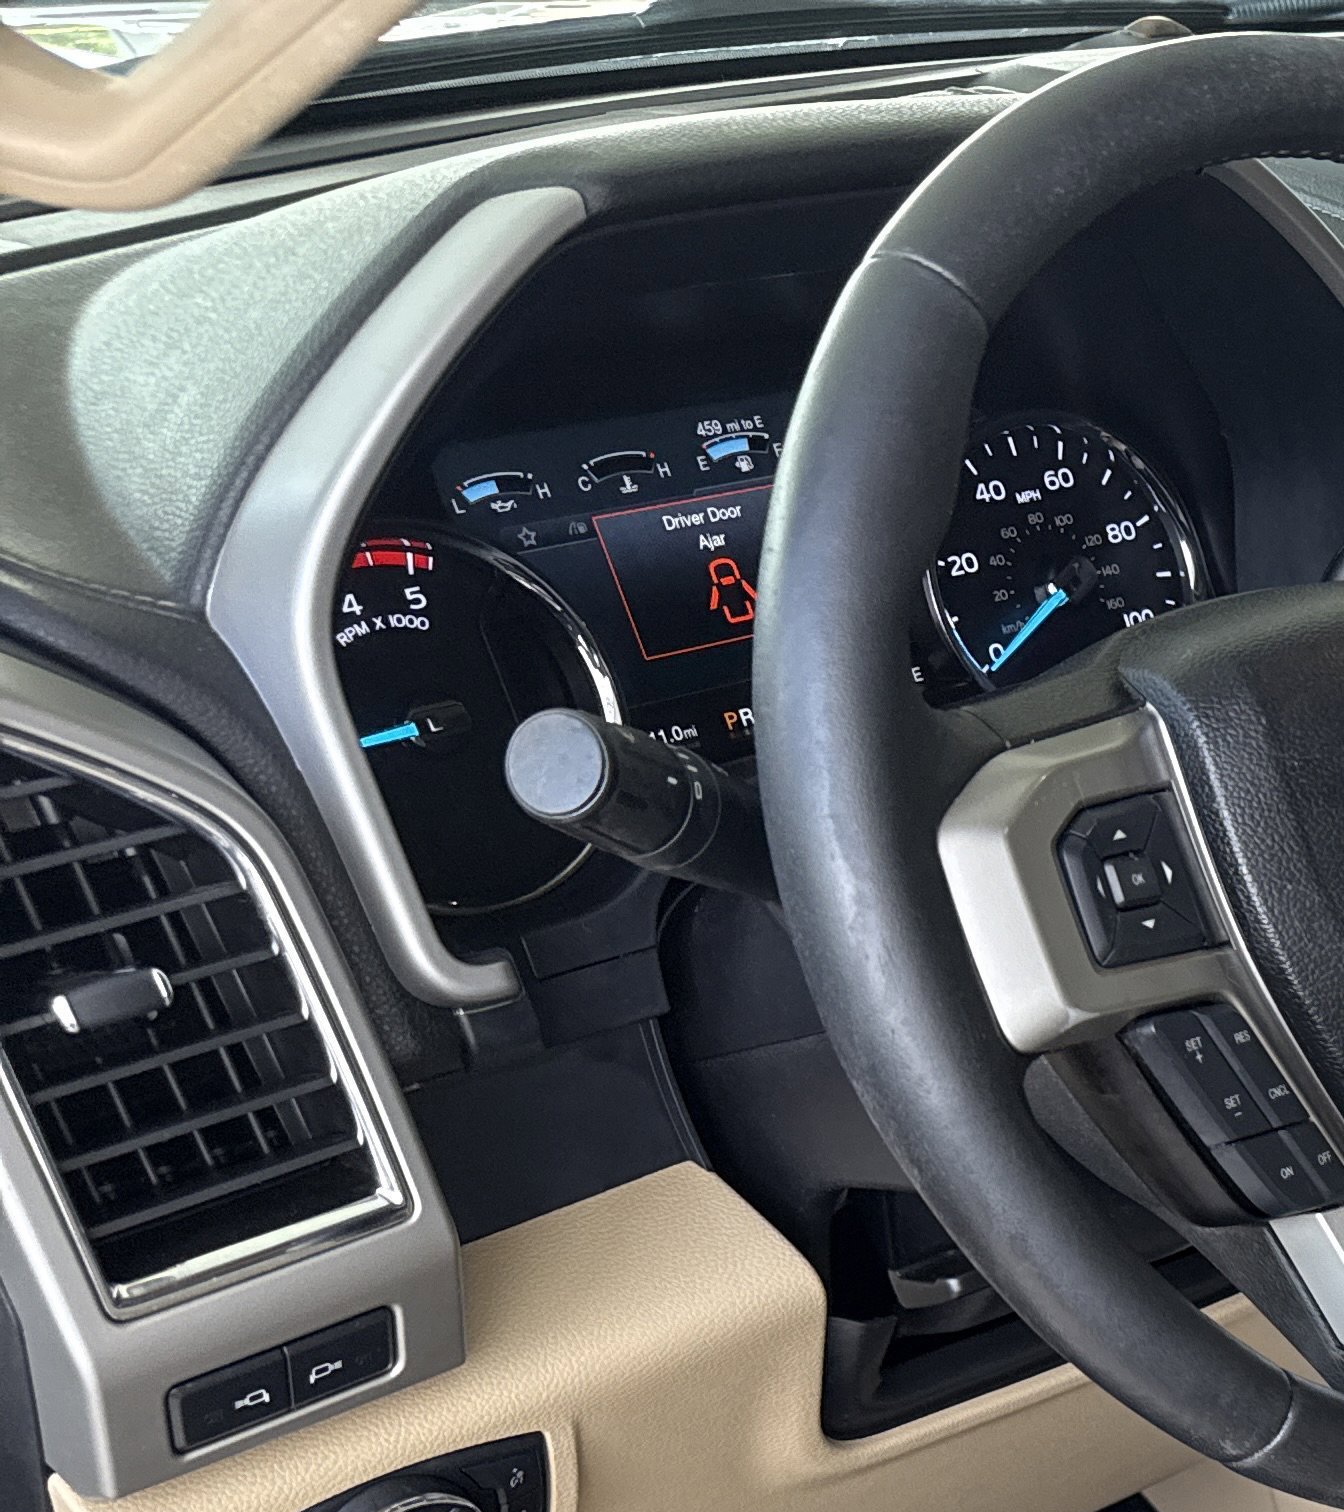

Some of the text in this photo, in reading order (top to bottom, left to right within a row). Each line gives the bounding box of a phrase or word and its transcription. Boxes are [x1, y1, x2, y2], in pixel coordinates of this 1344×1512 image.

[697, 415, 765, 437] 459 mi to E
[656, 461, 672, 478] H
[696, 455, 711, 471] E
[578, 475, 592, 492] C
[1043, 467, 1075, 491] 60
[536, 481, 552, 500] H
[975, 480, 1006, 503] 40
[1015, 488, 1042, 504] MPH
[452, 498, 466, 515] L
[662, 503, 743, 532] Driver Door
[1027, 512, 1045, 525] 80
[1054, 513, 1074, 527] 100
[1000, 526, 1018, 540] 60
[1106, 520, 1137, 544] 80
[699, 533, 726, 551] Ajar
[1085, 534, 1103, 547] 120
[947, 552, 979, 577] 20
[989, 554, 1006, 568] 40
[1101, 564, 1121, 577] 140
[341, 593, 363, 616] 4
[404, 586, 427, 610] 5
[992, 590, 1010, 603] 20
[335, 613, 430, 648] RPM X 1000
[1131, 872, 1146, 886] OK
[1185, 1036, 1203, 1051] SET
[1233, 1029, 1251, 1044] RES
[1224, 1094, 1241, 1110] SET
[1317, 1151, 1332, 1166] OFF
[1280, 1166, 1295, 1179] ON
